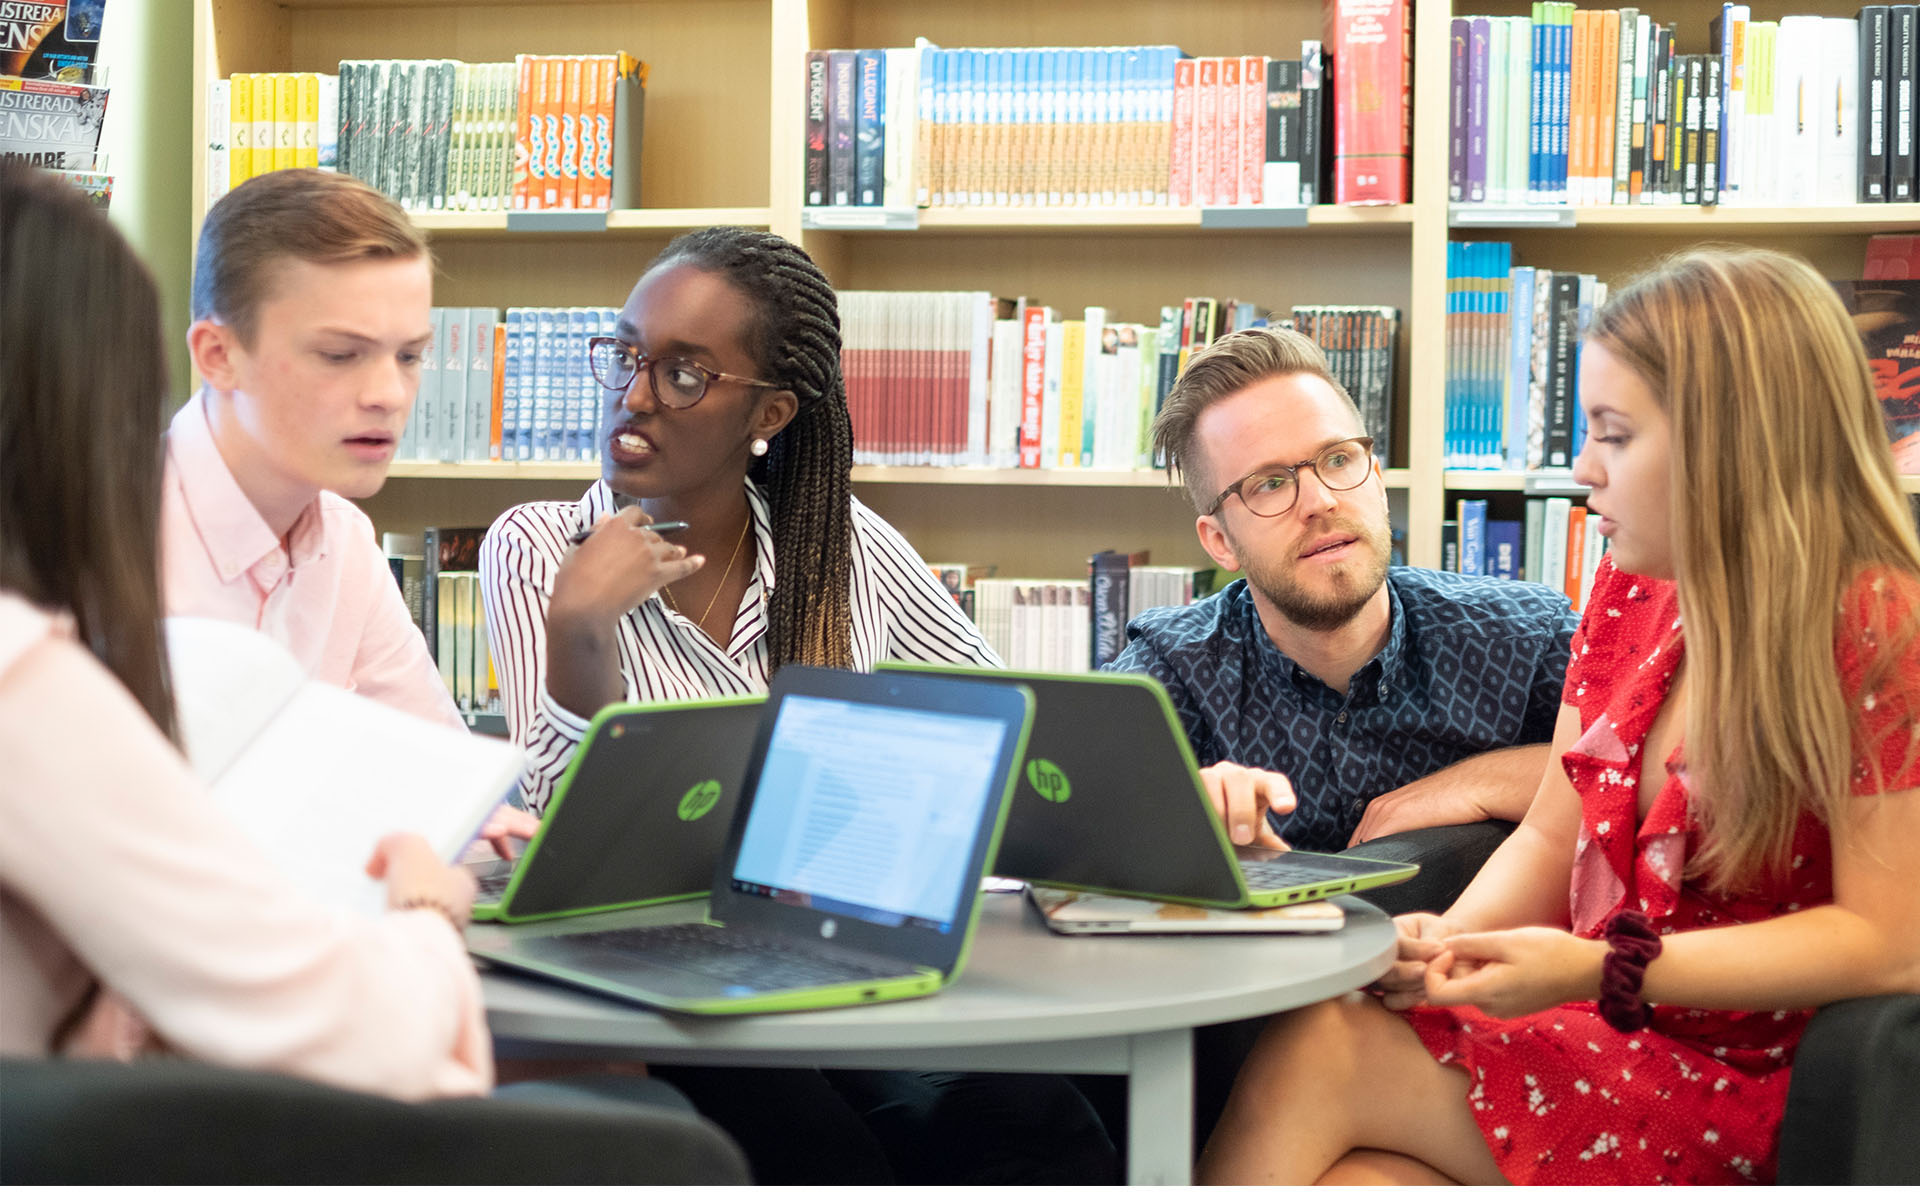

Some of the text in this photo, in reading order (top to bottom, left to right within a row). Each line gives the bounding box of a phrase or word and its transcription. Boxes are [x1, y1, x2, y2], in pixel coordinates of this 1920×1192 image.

[1875, 14, 1883, 44] BIRGITTA
[1902, 14, 1911, 44] BIRGITTA
[809, 61, 825, 122] DIVERGENT
[836, 63, 850, 121] INSURGENT
[863, 57, 876, 121] ALLEGIANT
[681, 782, 719, 821] hp
[1031, 759, 1067, 802] hp
